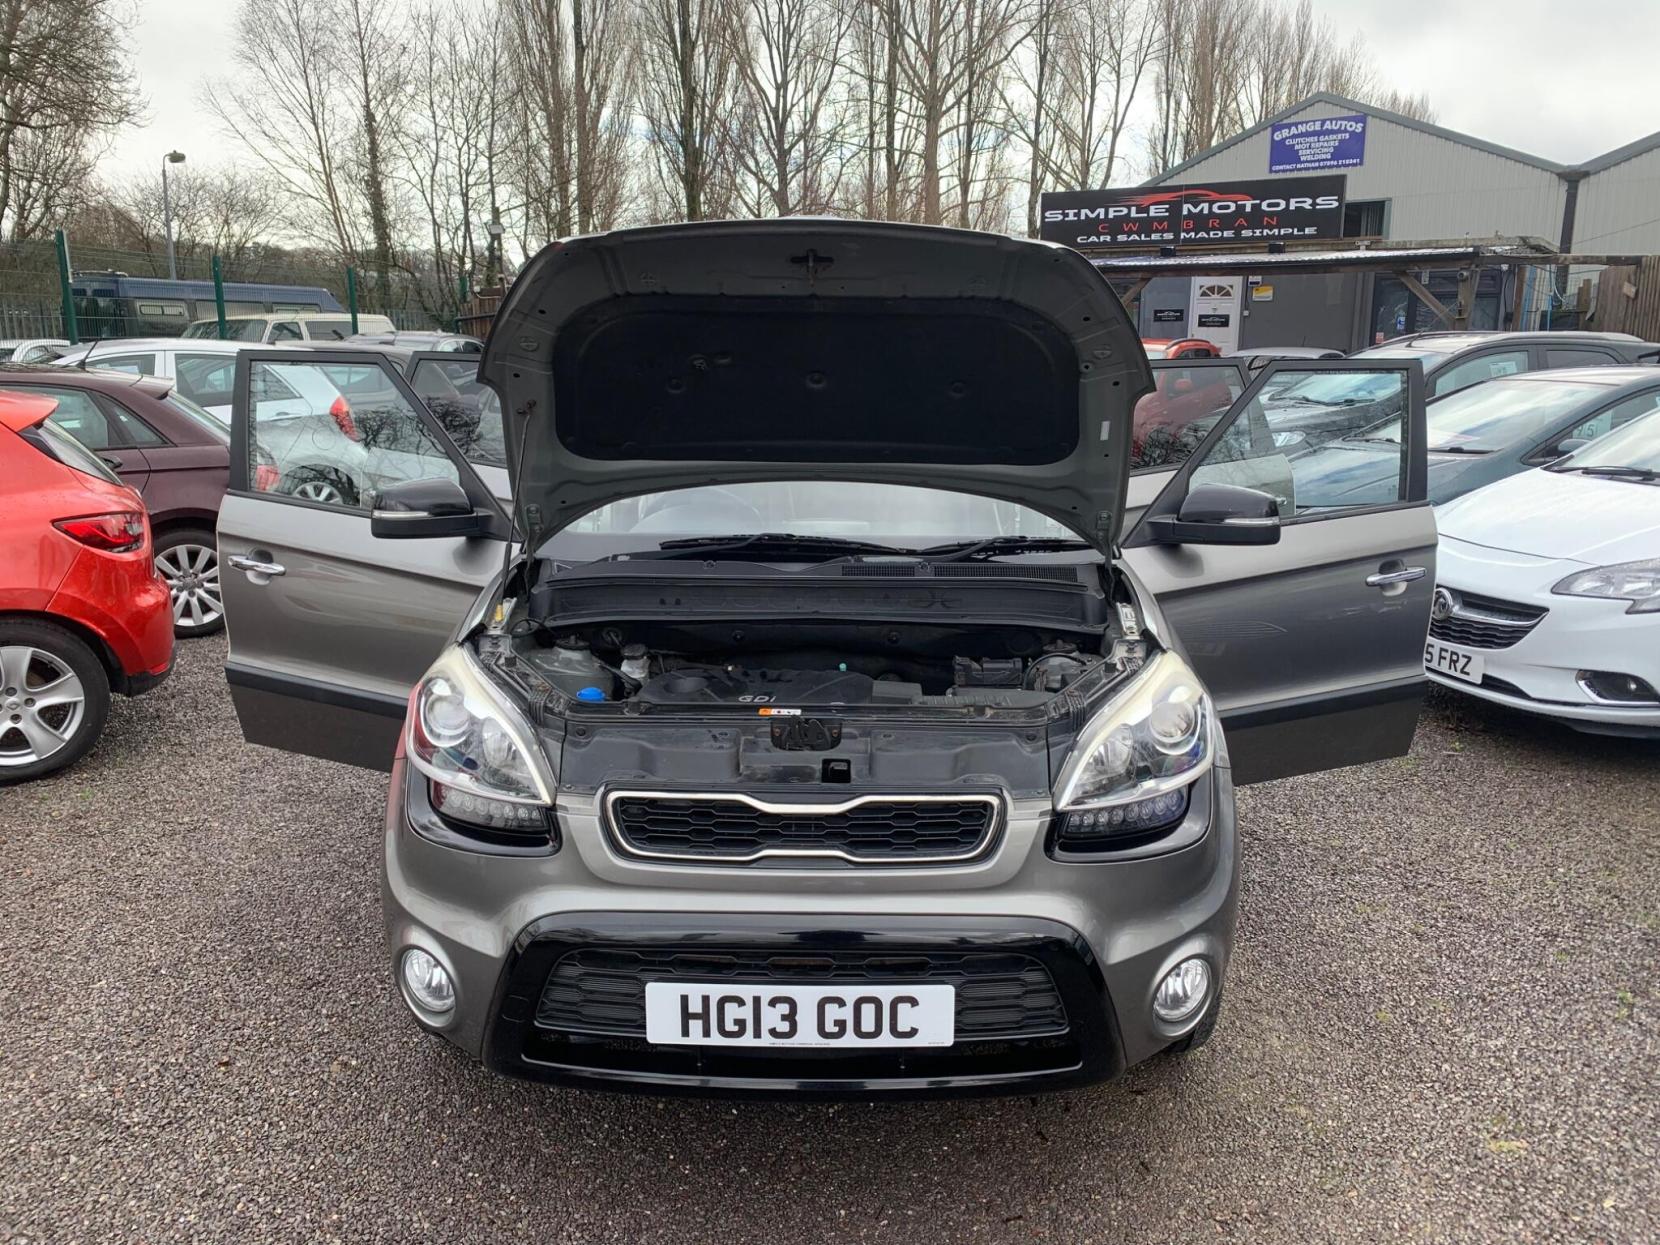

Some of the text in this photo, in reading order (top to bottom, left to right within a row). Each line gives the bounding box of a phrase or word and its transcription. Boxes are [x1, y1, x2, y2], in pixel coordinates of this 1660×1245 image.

[1273, 120, 1364, 141] GRANGE AUTOS
[1285, 133, 1350, 145] CLUTCHES GASKETS
[1298, 147, 1334, 155] SERVICING
[1300, 153, 1331, 161] WELDING
[1044, 195, 1340, 222] SIMPLE MOTORS
[1098, 216, 1278, 232] CWMBRAN
[1077, 226, 1318, 244] CAR SALES MADE SIMPLE
[1437, 647, 1472, 676] FRZ
[679, 994, 920, 1040] HG13 GOC
